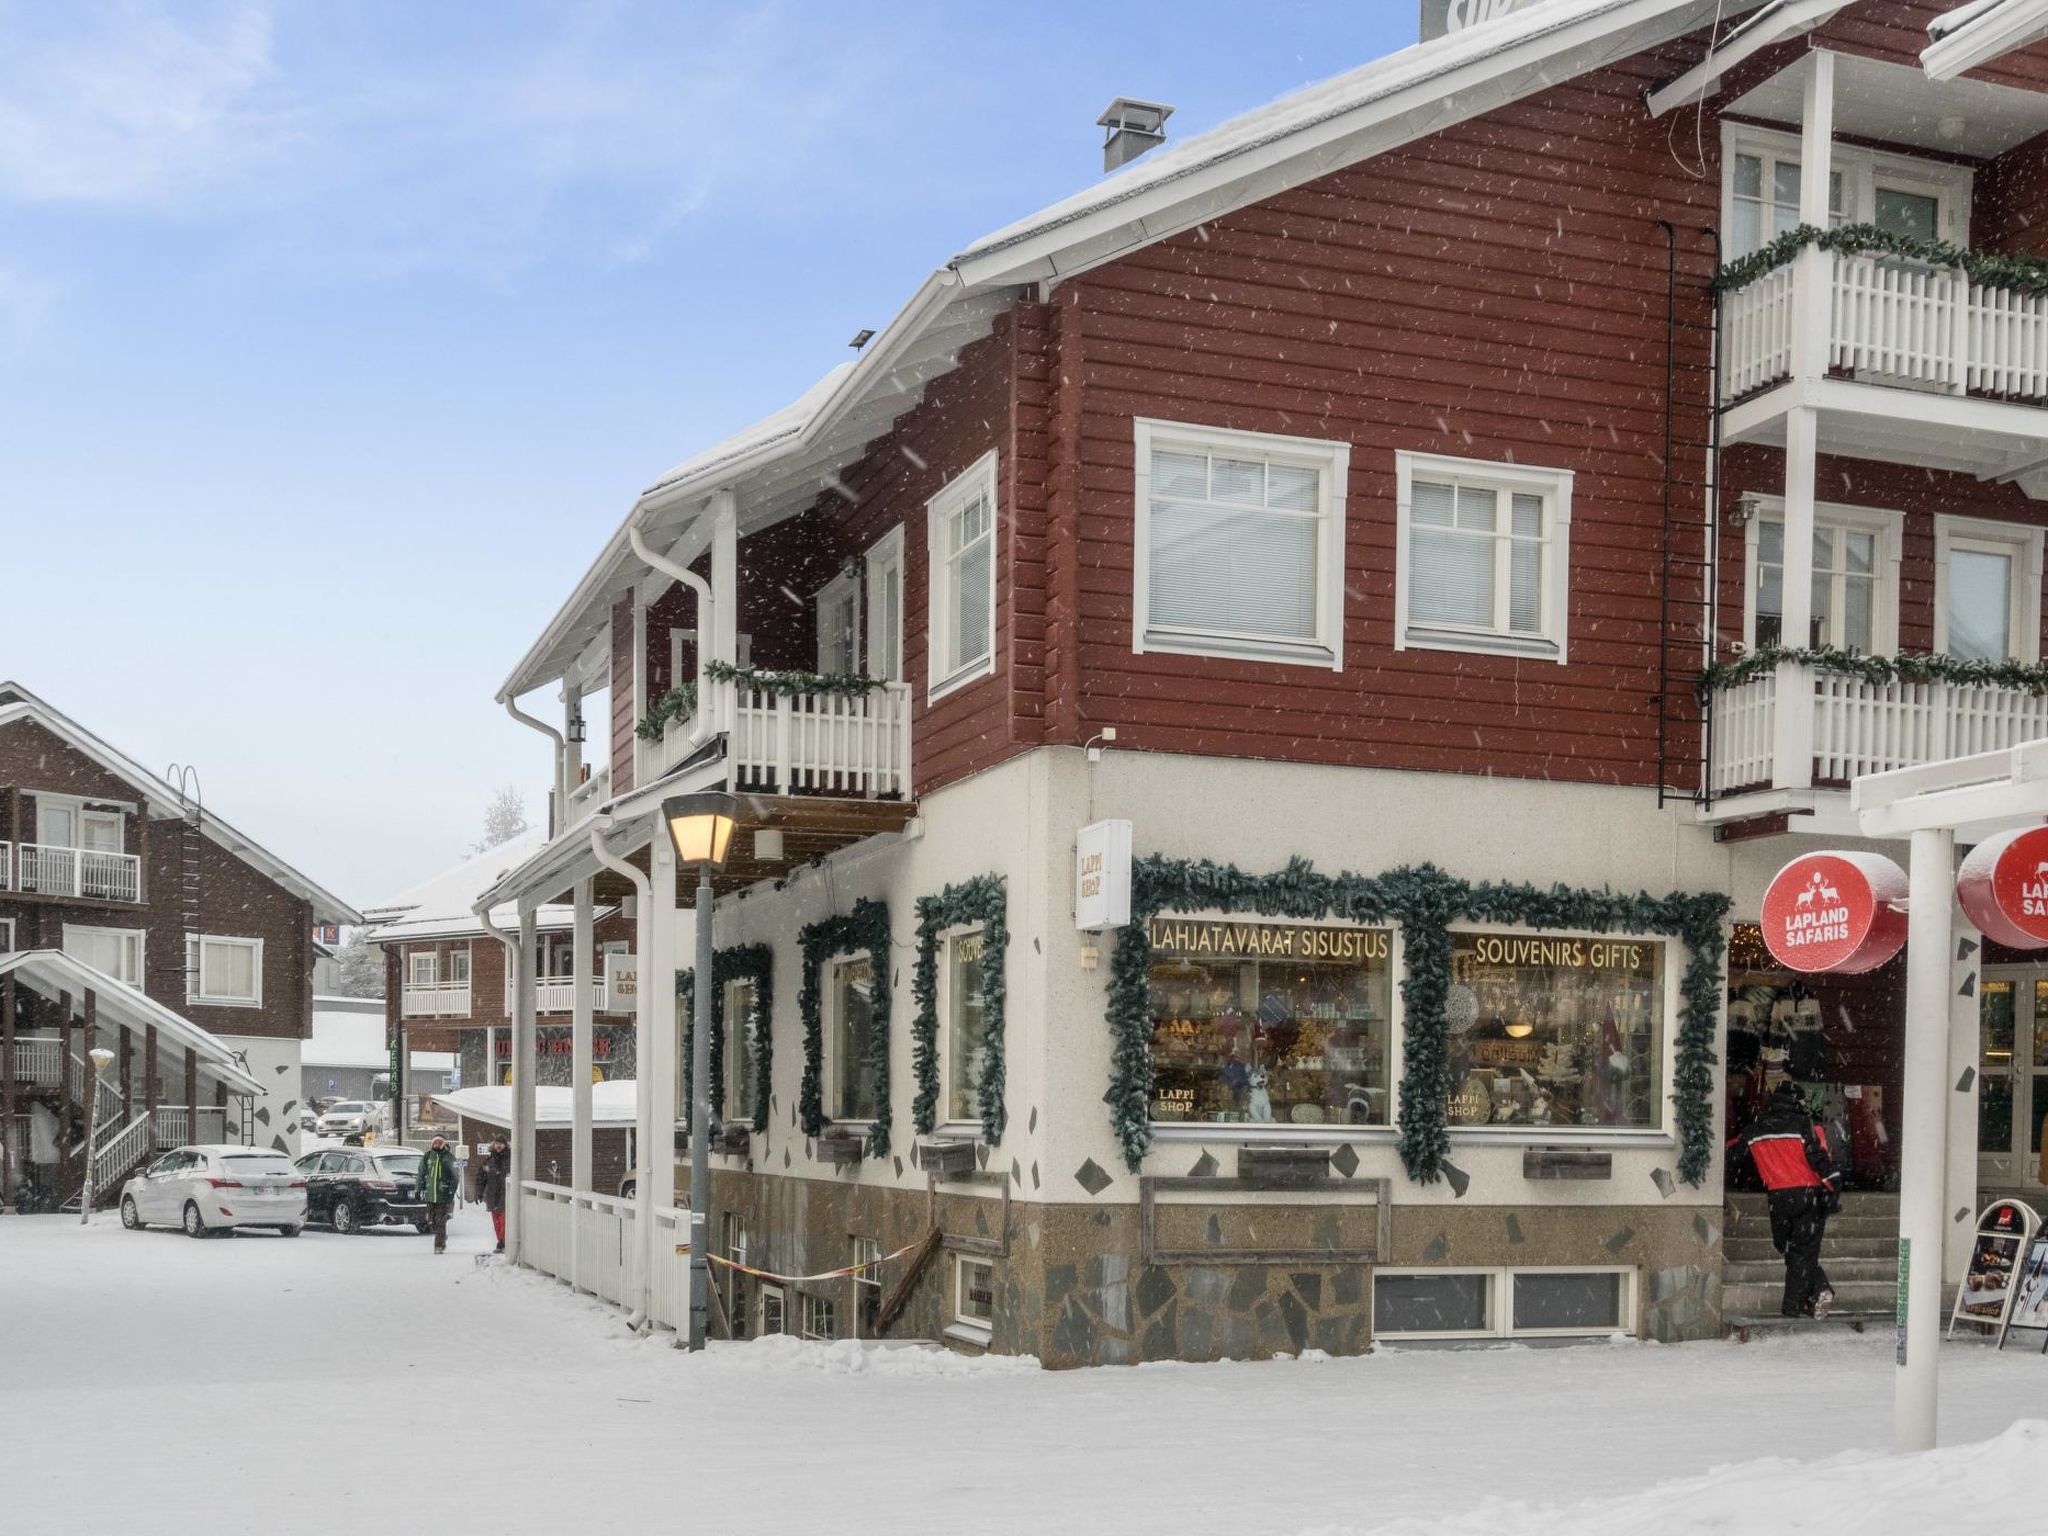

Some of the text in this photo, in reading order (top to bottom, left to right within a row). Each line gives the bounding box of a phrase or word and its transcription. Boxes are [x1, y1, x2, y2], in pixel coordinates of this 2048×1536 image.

[2023, 899, 2048, 915] SA
[1785, 906, 1849, 931] LAPLAND
[1152, 924, 1388, 959] LAHJATAVARAT SISUSTUS
[1786, 923, 1849, 947] SAFARIS
[1476, 937, 1640, 969] SOUVENIRS GIFTS
[616, 983, 637, 995] SH
[390, 1039, 398, 1091] KEBAB
[1159, 1088, 1195, 1100] LAPPI
[1447, 1094, 1479, 1105] LAPPI
[1160, 1100, 1193, 1112] SHOP
[1448, 1106, 1477, 1116] SHOP
